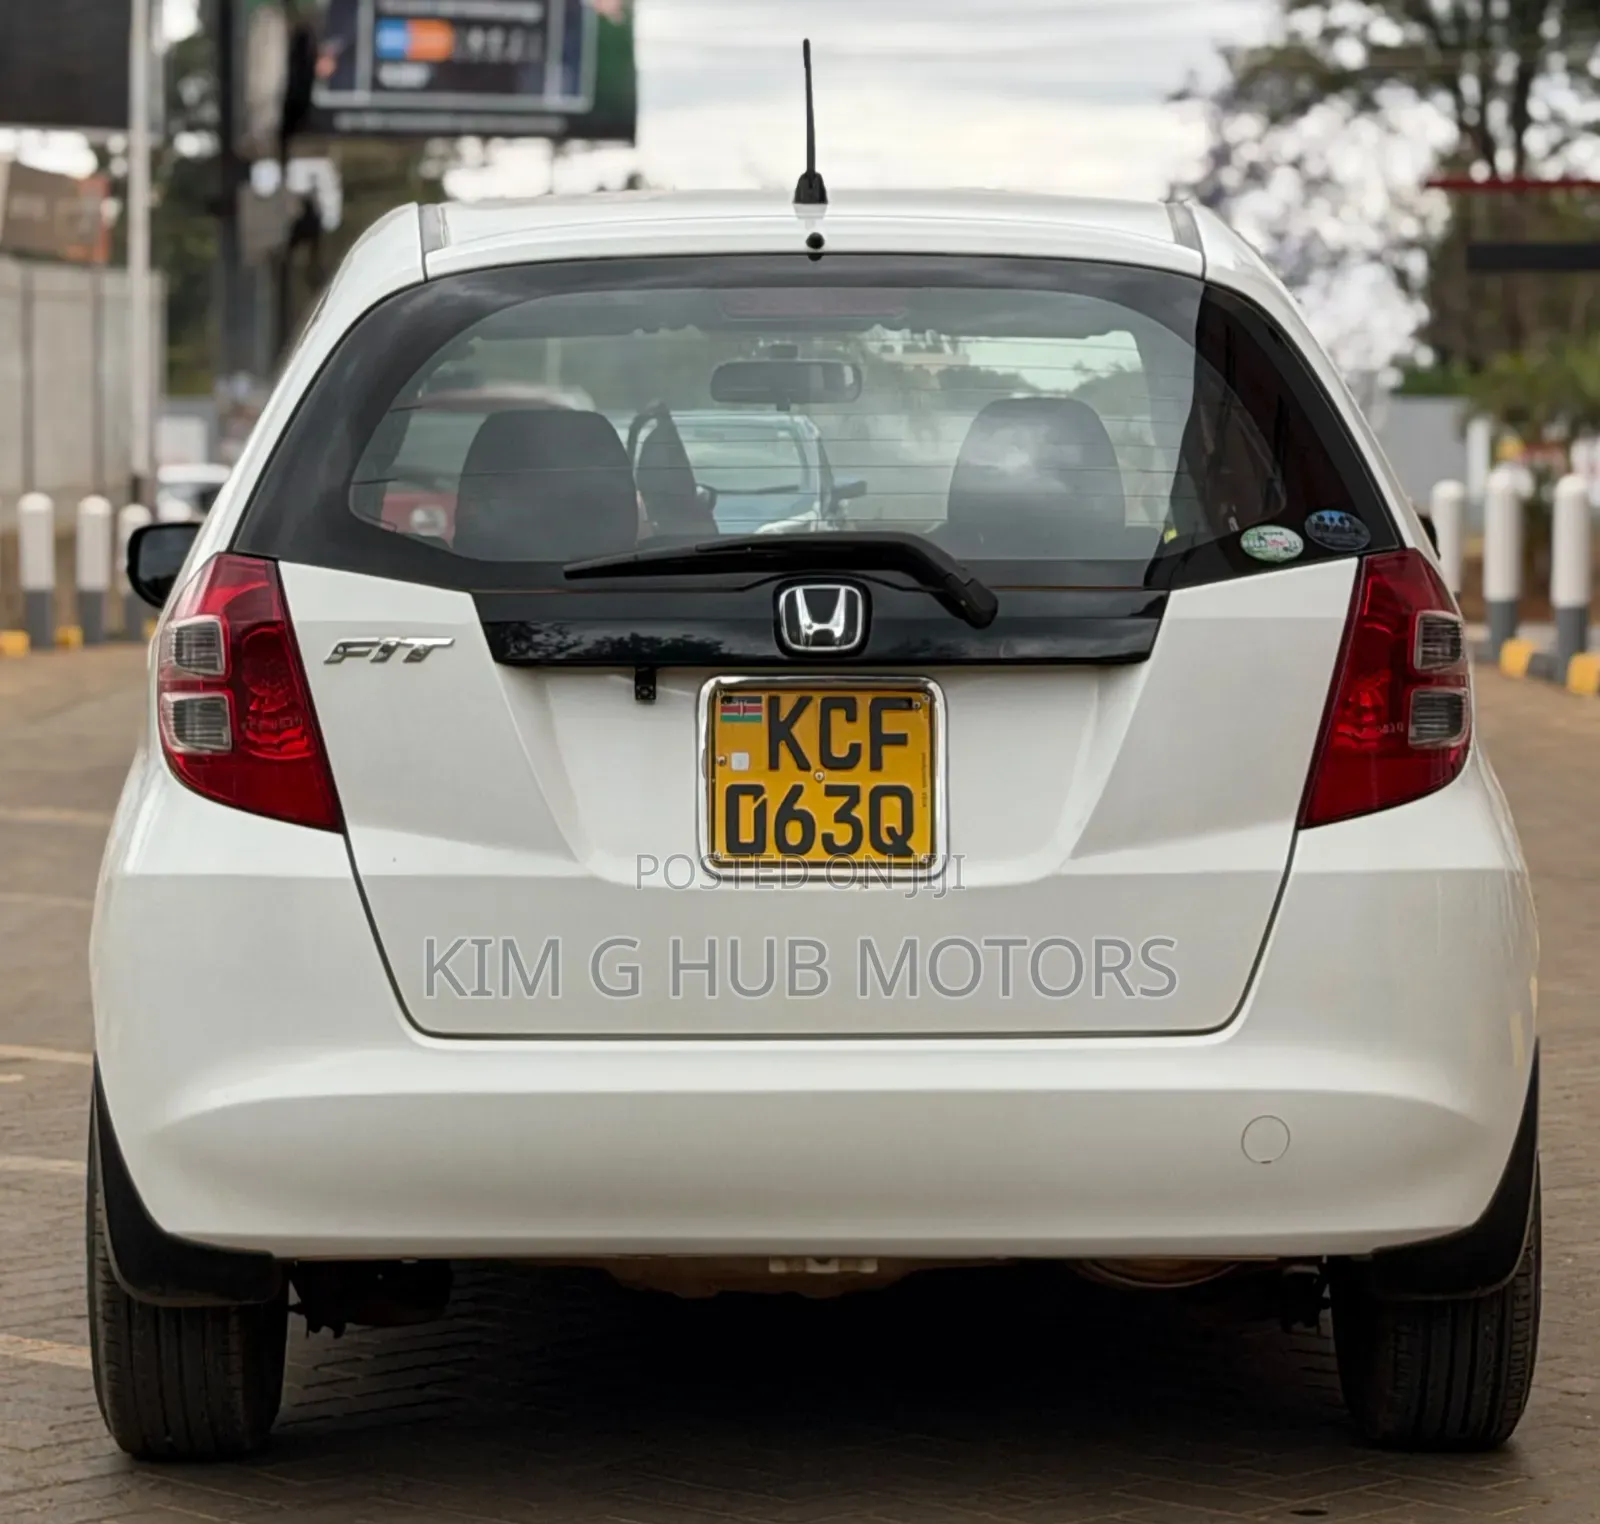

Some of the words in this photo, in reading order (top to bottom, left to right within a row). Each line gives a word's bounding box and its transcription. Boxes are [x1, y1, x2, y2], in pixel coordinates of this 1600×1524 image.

[323, 637, 455, 664] FIT
[768, 696, 912, 771] KCF
[725, 784, 914, 857] 063Q
